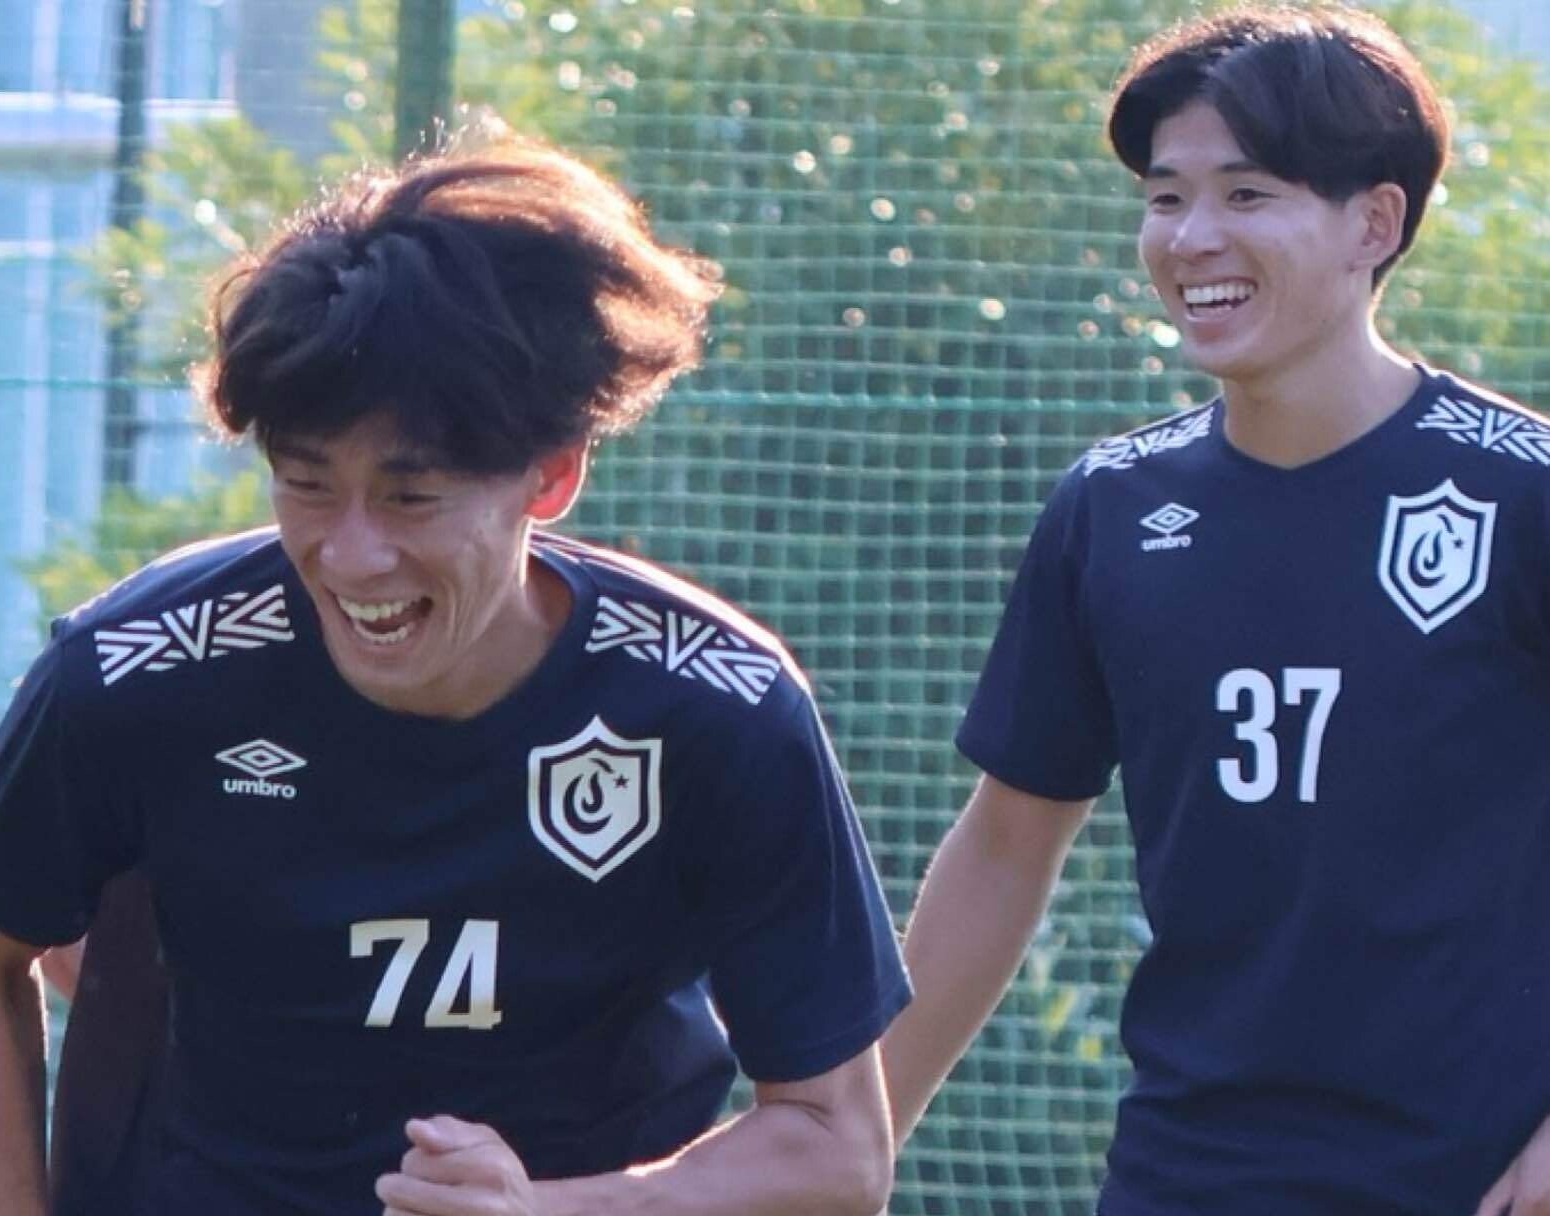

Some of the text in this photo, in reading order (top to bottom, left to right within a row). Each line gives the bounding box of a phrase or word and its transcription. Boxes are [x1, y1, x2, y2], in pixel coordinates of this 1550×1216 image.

[1142, 534, 1191, 551] umbro
[1217, 667, 1341, 803] 37
[223, 777, 297, 798] umbro
[349, 918, 503, 1030] 74
